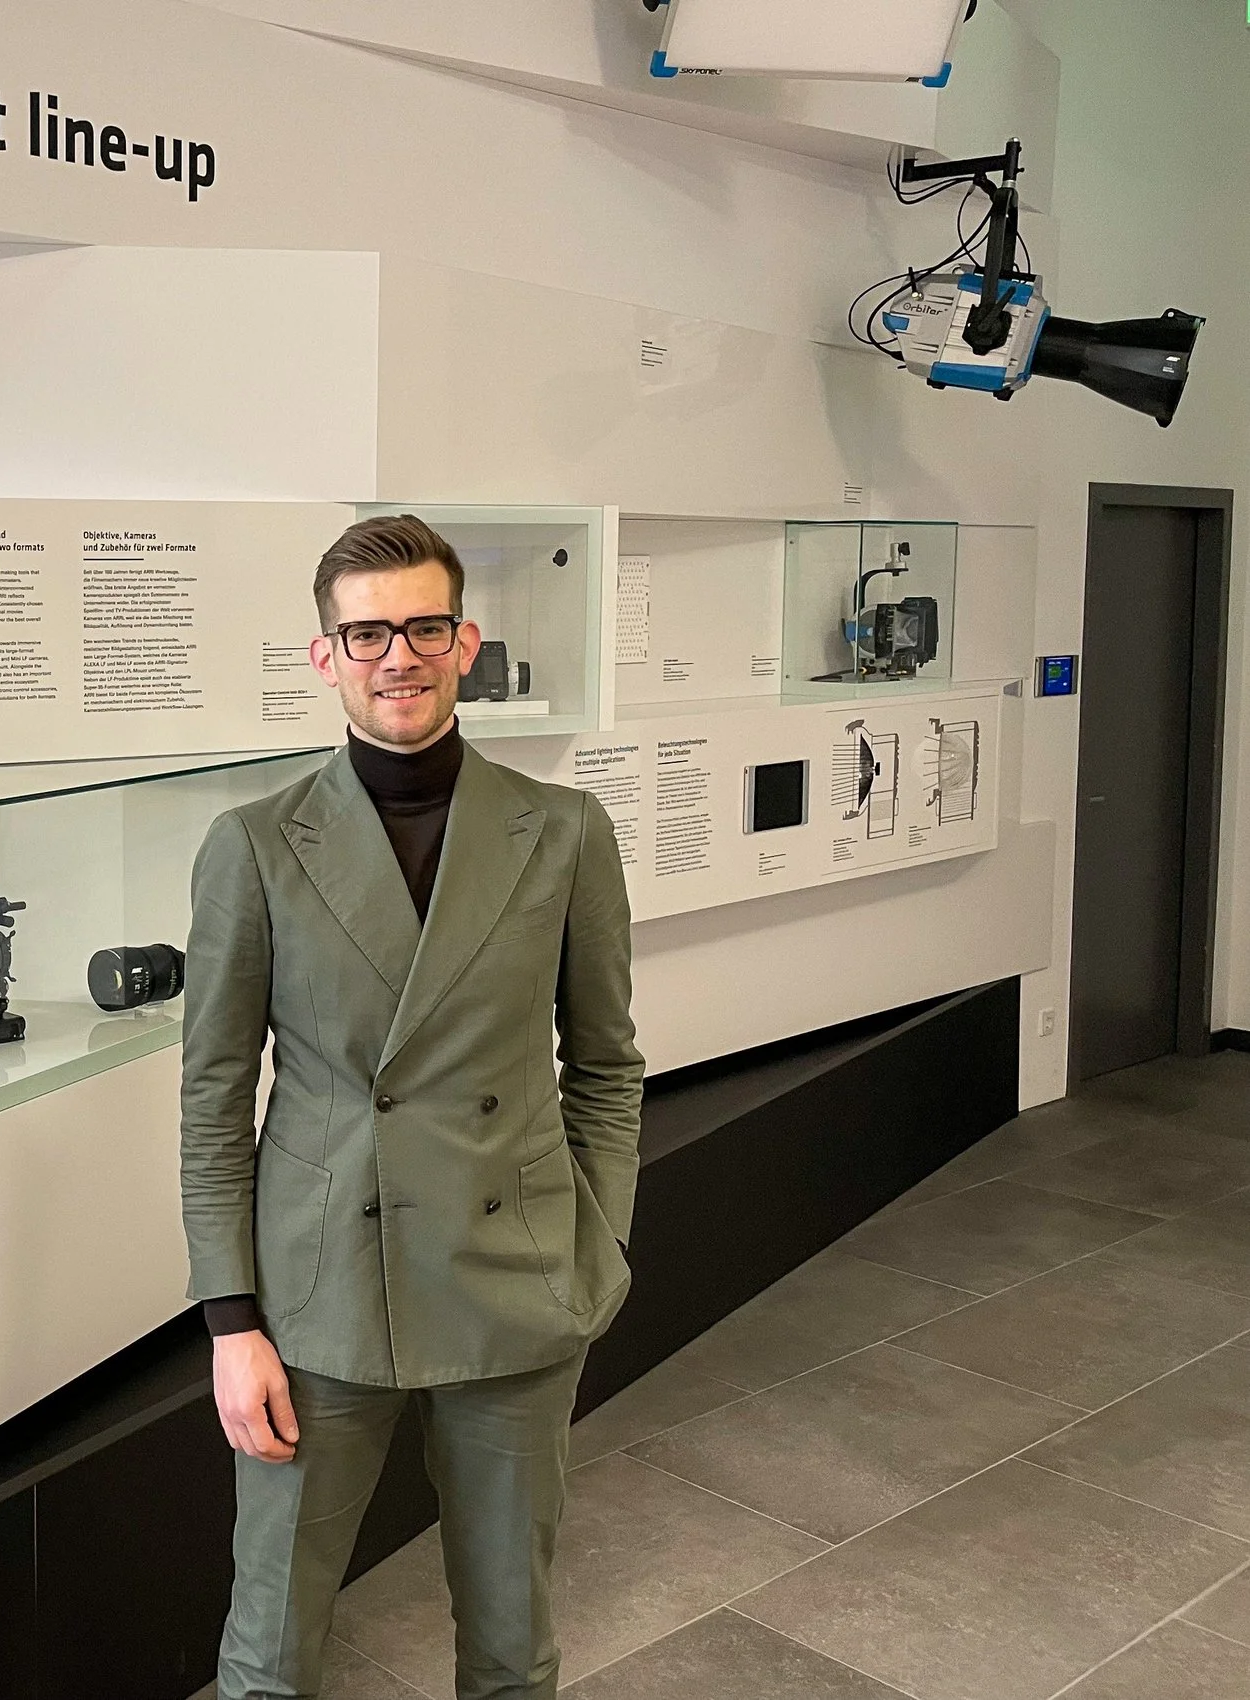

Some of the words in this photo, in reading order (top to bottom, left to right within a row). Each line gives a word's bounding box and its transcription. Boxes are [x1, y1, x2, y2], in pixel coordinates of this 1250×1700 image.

[29, 92, 215, 202] line-up
[83, 531, 122, 541] Objektive,
[13, 543, 45, 551] formats
[575, 748, 596, 757] Advanced
